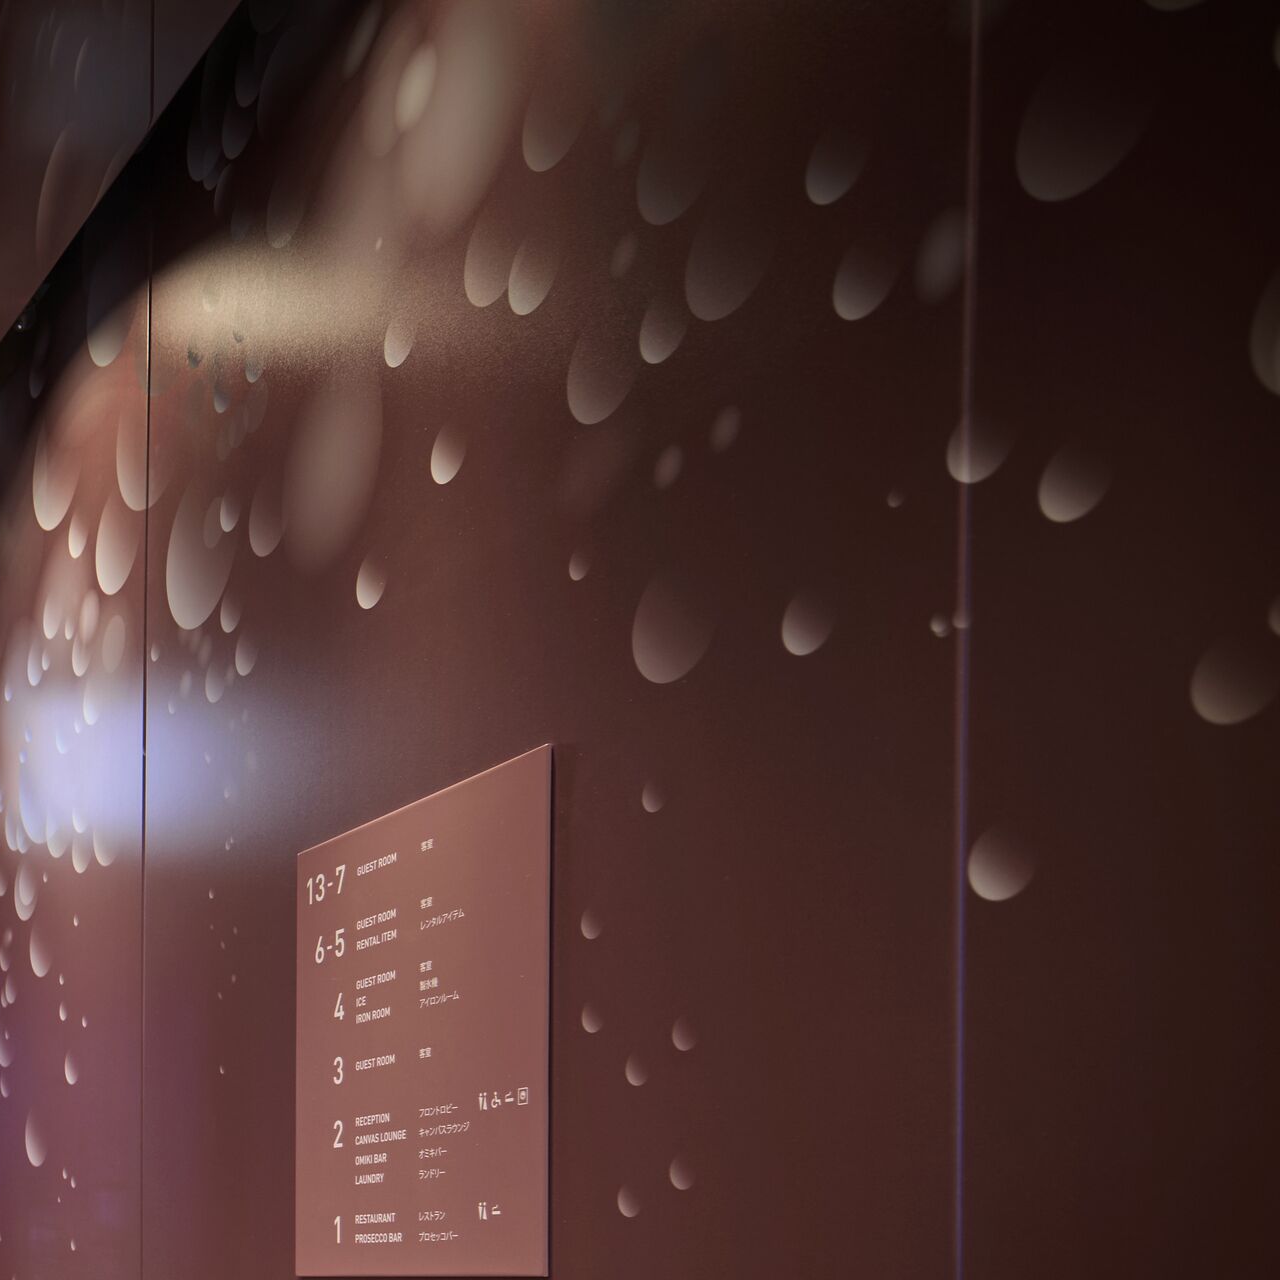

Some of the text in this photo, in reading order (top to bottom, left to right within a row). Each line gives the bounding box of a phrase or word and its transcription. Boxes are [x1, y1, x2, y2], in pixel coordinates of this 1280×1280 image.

[357, 852, 397, 876] GUEST ROOM
[306, 864, 346, 905] 13-7
[356, 908, 397, 931] GUEST ROOM
[420, 908, 465, 931] レンタルアイテム
[315, 928, 345, 964] 6-5
[356, 929, 397, 951] RENTAL ITEM
[356, 970, 396, 990] GUEST ROOM
[333, 992, 345, 1020] 4
[355, 995, 367, 1008] ICE
[419, 990, 460, 1009] アイロンルーム
[355, 1006, 391, 1024] IRON ROOM
[333, 1056, 344, 1085] 3
[355, 1054, 396, 1071] GUEST ROOM
[419, 1103, 459, 1118] フロントロビー
[355, 1112, 390, 1127] RECEPTION
[333, 1119, 344, 1149] 2
[355, 1129, 407, 1146] CANVAS LOUNGE
[355, 1152, 387, 1166] OMIKI BAR
[419, 1147, 447, 1159] オミキバー
[355, 1172, 385, 1185] LAUNDRY
[419, 1168, 446, 1179] ランドリー
[354, 1212, 396, 1225] RESTAURANT
[418, 1211, 446, 1222] レストラン
[333, 1215, 341, 1244] 1
[354, 1232, 403, 1244] PROSECCO BAR
[418, 1231, 459, 1242] プロセッコバー
